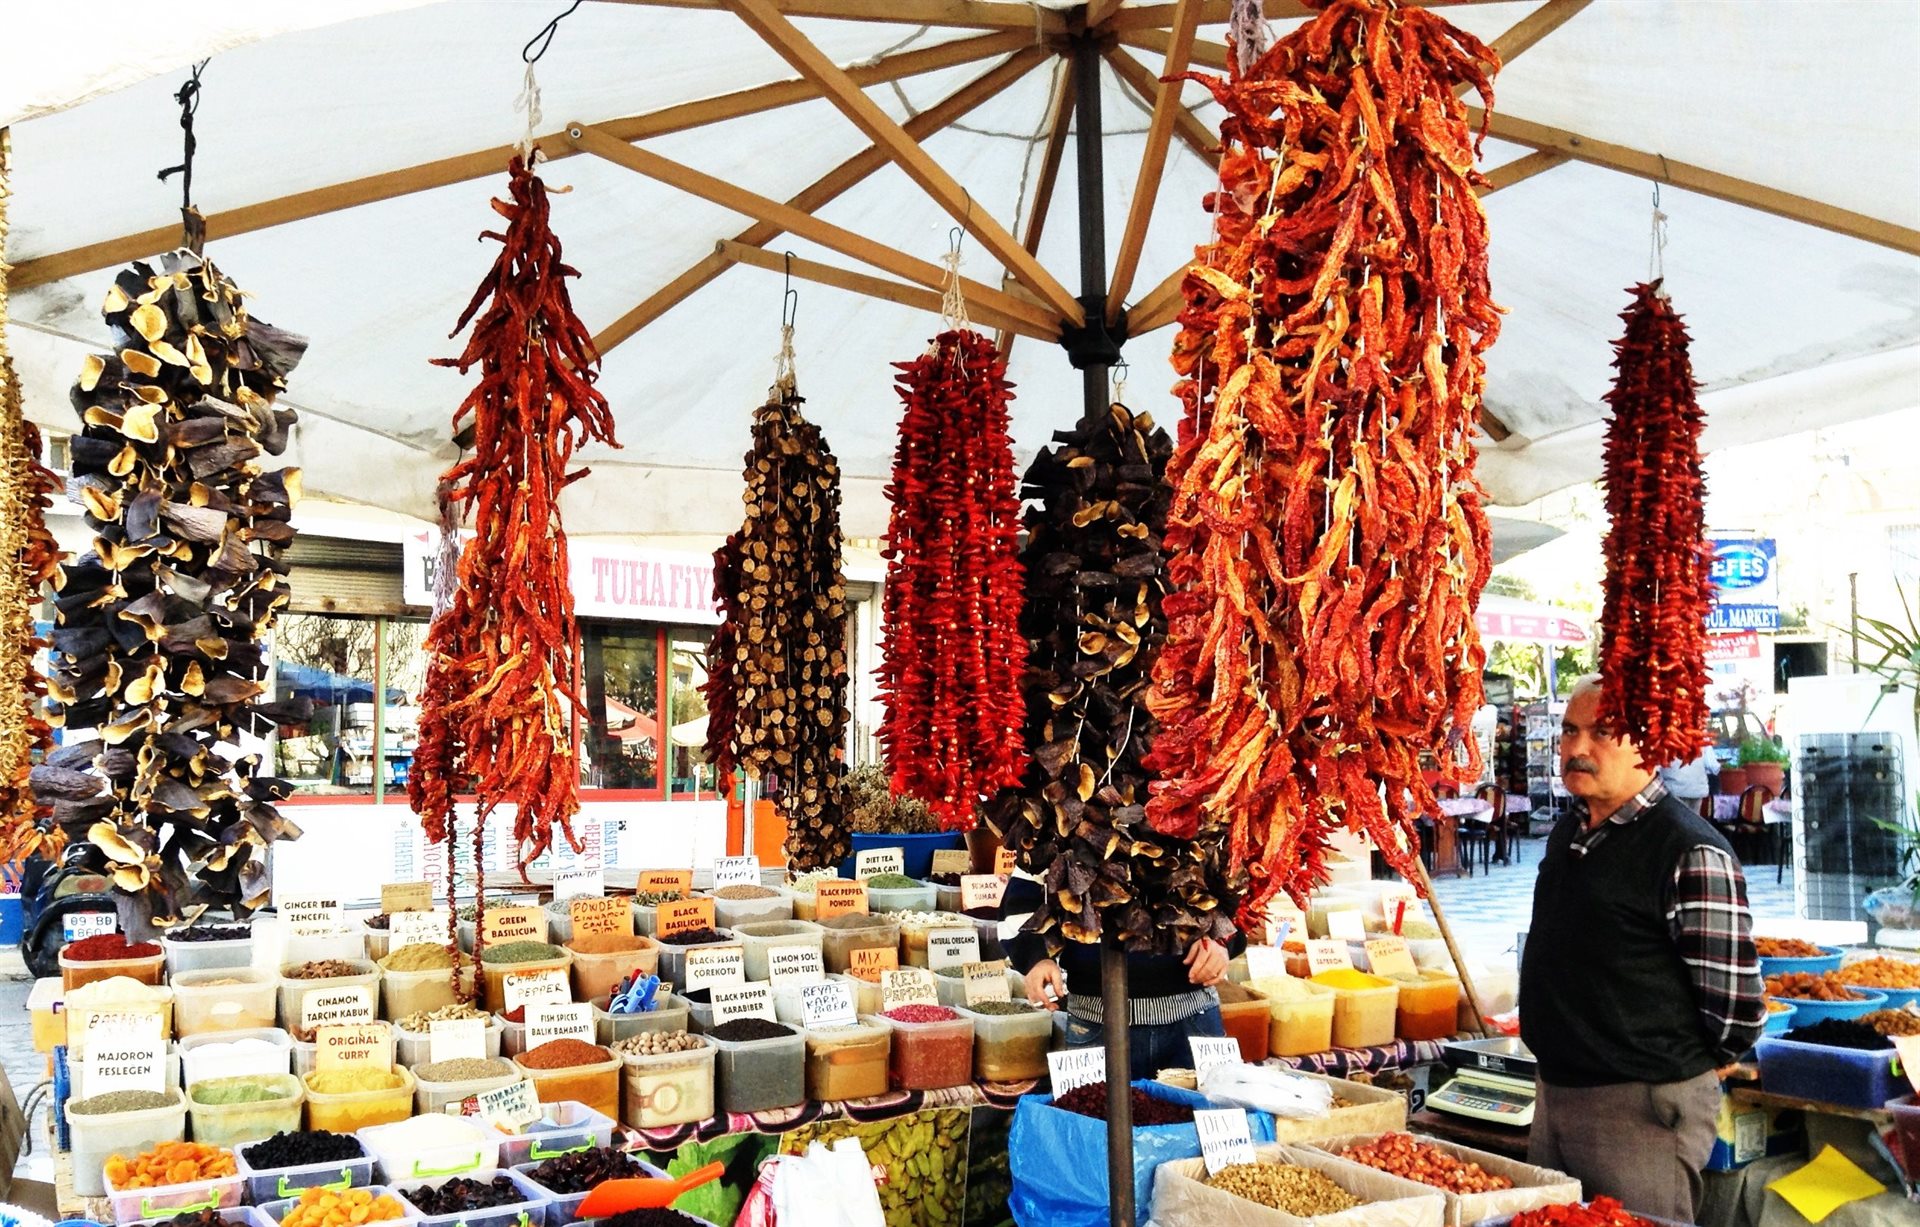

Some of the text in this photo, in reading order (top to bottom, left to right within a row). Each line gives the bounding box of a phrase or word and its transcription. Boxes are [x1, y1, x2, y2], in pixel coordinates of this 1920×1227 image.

[1711, 558, 1765, 578] EFES
[592, 556, 715, 610] TUHAFİY
[1729, 608, 1778, 628] MARKET
[866, 856, 880, 864] DIET
[860, 866, 882, 875] FUNDA
[820, 887, 864, 896] BLACK PEPPER
[284, 900, 337, 910] GINGER TEA
[573, 898, 627, 913] POWDER
[829, 899, 855, 907] POWDER
[290, 913, 331, 922] ZENCEFIL
[672, 907, 699, 918] BLACK
[499, 916, 527, 925] GREEN
[582, 920, 615, 930] CANEL
[665, 918, 707, 930] BASILICUM
[491, 927, 538, 938] BASILICUM
[931, 936, 976, 945] NATURAL OREGANO
[689, 957, 715, 966] BLACK
[772, 954, 799, 964] LEMON
[857, 951, 881, 965] MIX
[889, 971, 922, 989] RED
[517, 983, 564, 998] PEPPER
[715, 989, 767, 1003] BLACK PEPPER
[882, 983, 938, 1003] PEPPER
[317, 995, 359, 1007] CINAMON
[307, 1007, 369, 1022] TARÇIN KABUK
[540, 1012, 578, 1023] FISH SPICES
[531, 1027, 552, 1036] BALIK
[328, 1035, 379, 1046] ORIGINAL
[97, 1051, 153, 1061] MAJORON
[338, 1050, 370, 1060] CURRY
